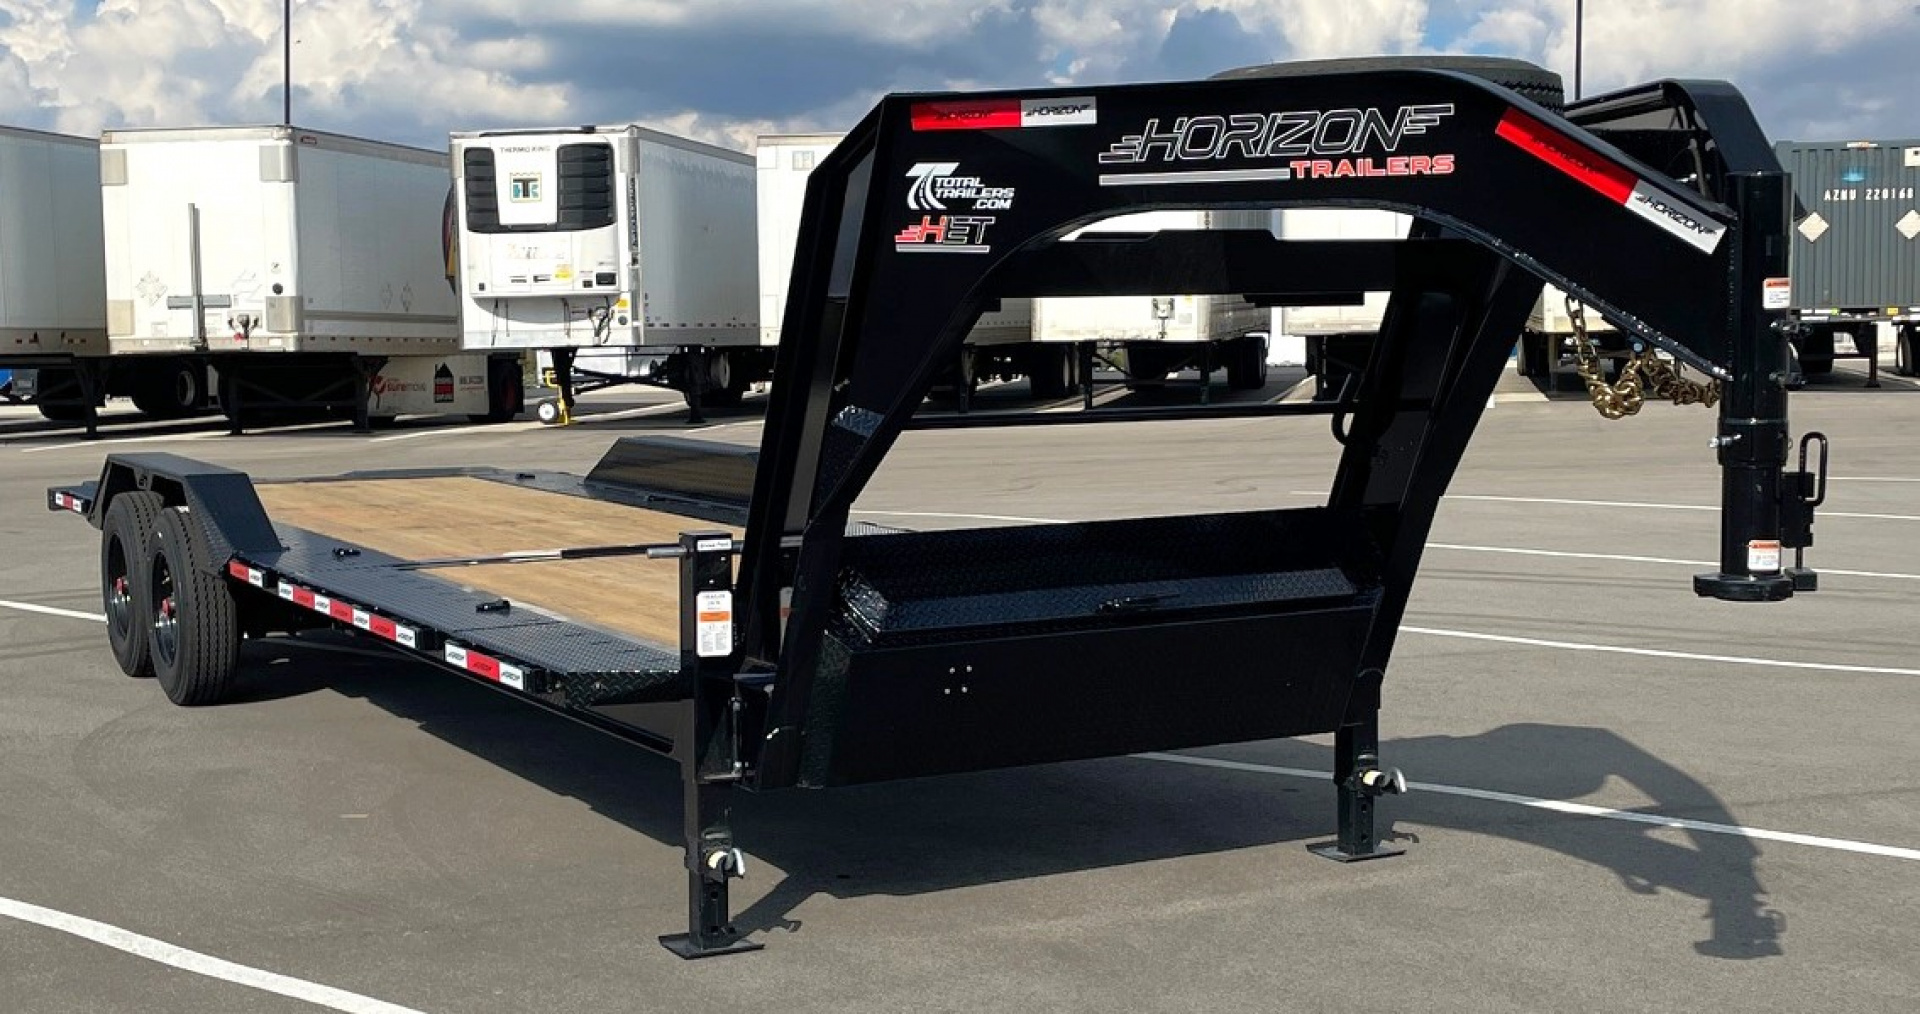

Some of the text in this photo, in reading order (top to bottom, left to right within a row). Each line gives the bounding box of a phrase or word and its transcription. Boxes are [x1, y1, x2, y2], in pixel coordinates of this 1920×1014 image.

[1027, 104, 1089, 116] HORIZON
[1110, 104, 1446, 162] HORIZON
[499, 146, 530, 154] THERMO
[1290, 154, 1455, 178] TRAILERS
[935, 177, 985, 187] TOTAL
[934, 187, 1015, 199] TRAILERS
[972, 199, 1012, 209] .COM
[1640, 195, 1711, 234] HORIZON
[904, 215, 996, 244] HET
